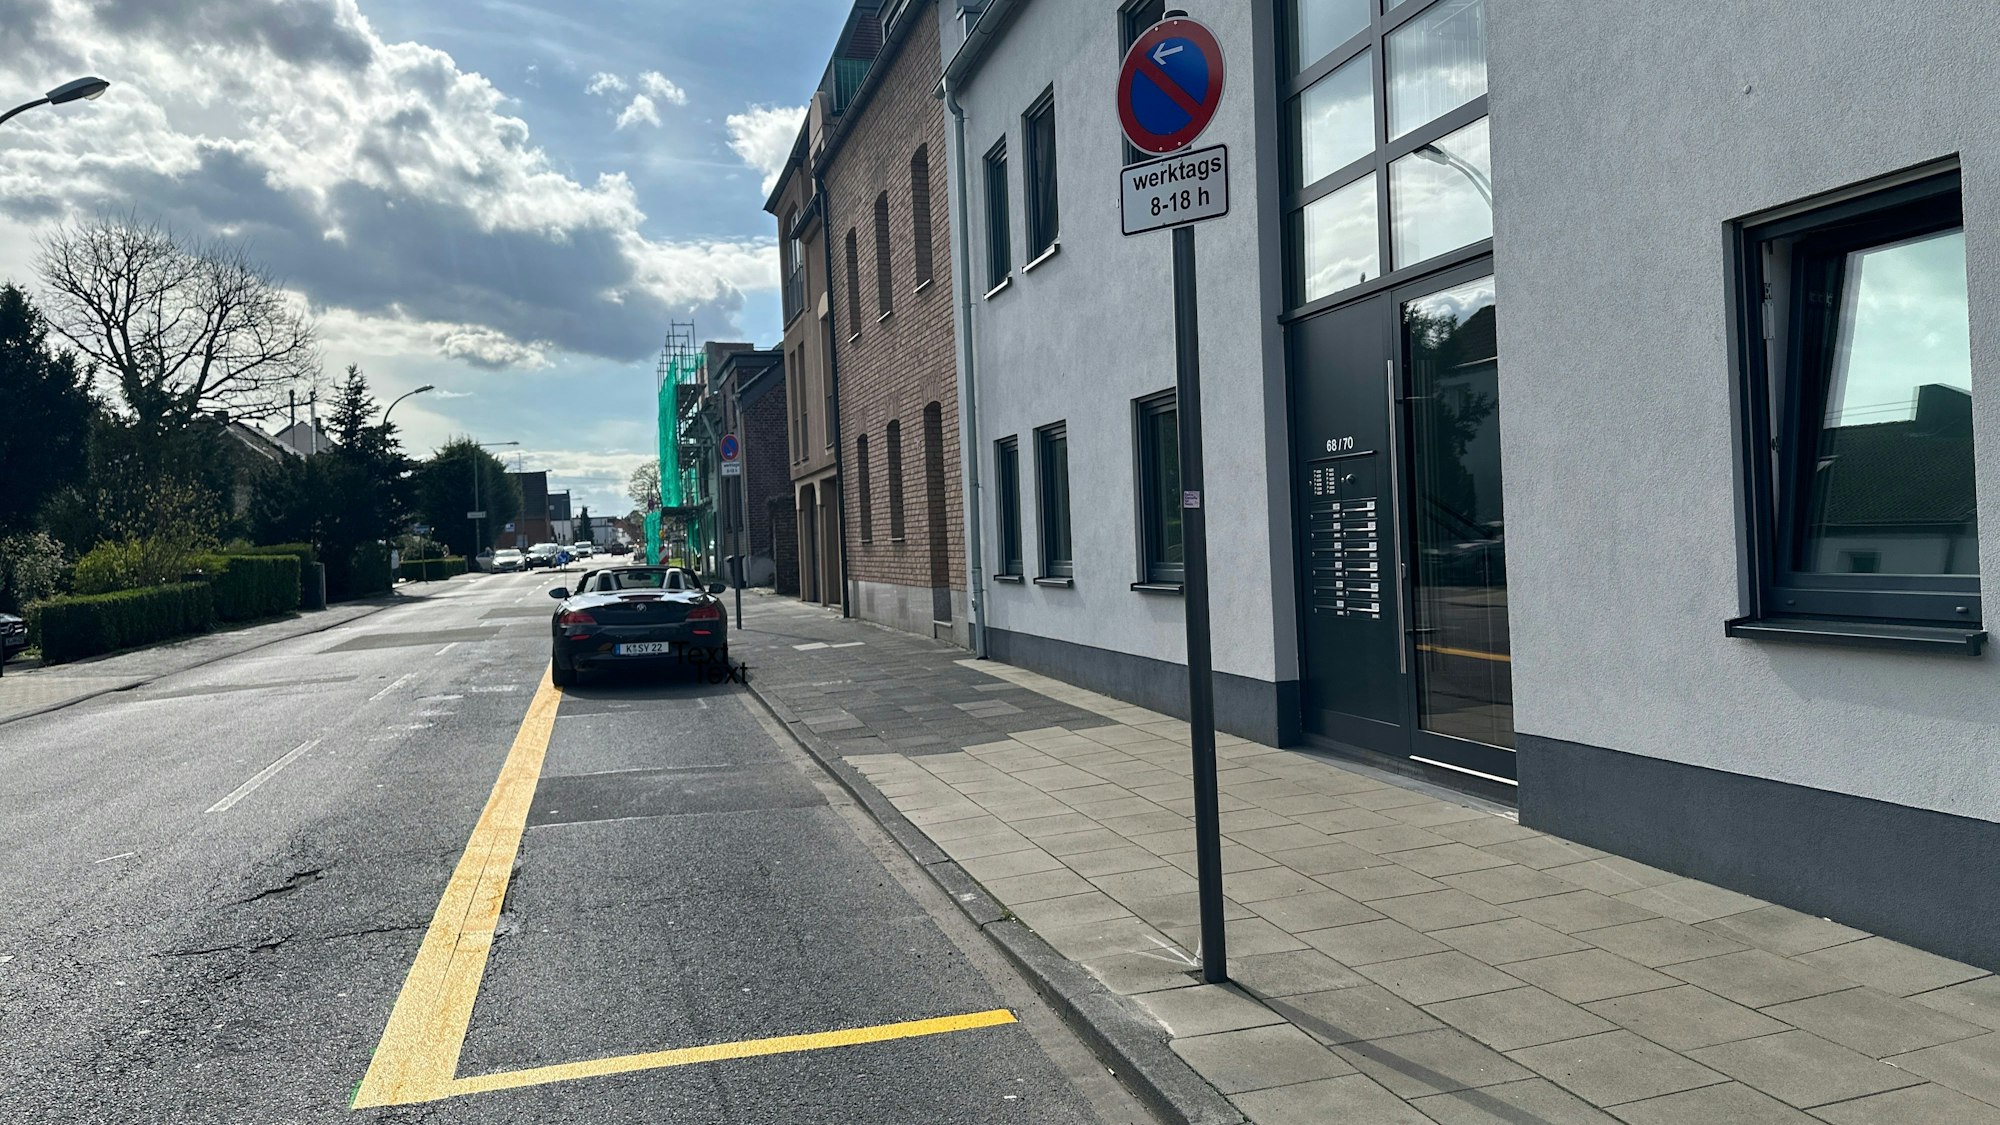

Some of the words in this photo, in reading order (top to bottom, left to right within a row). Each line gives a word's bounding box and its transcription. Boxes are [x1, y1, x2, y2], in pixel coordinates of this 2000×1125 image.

[1133, 156, 1222, 191] werktags
[1150, 189, 1191, 216] 8-18
[1198, 186, 1210, 207] h
